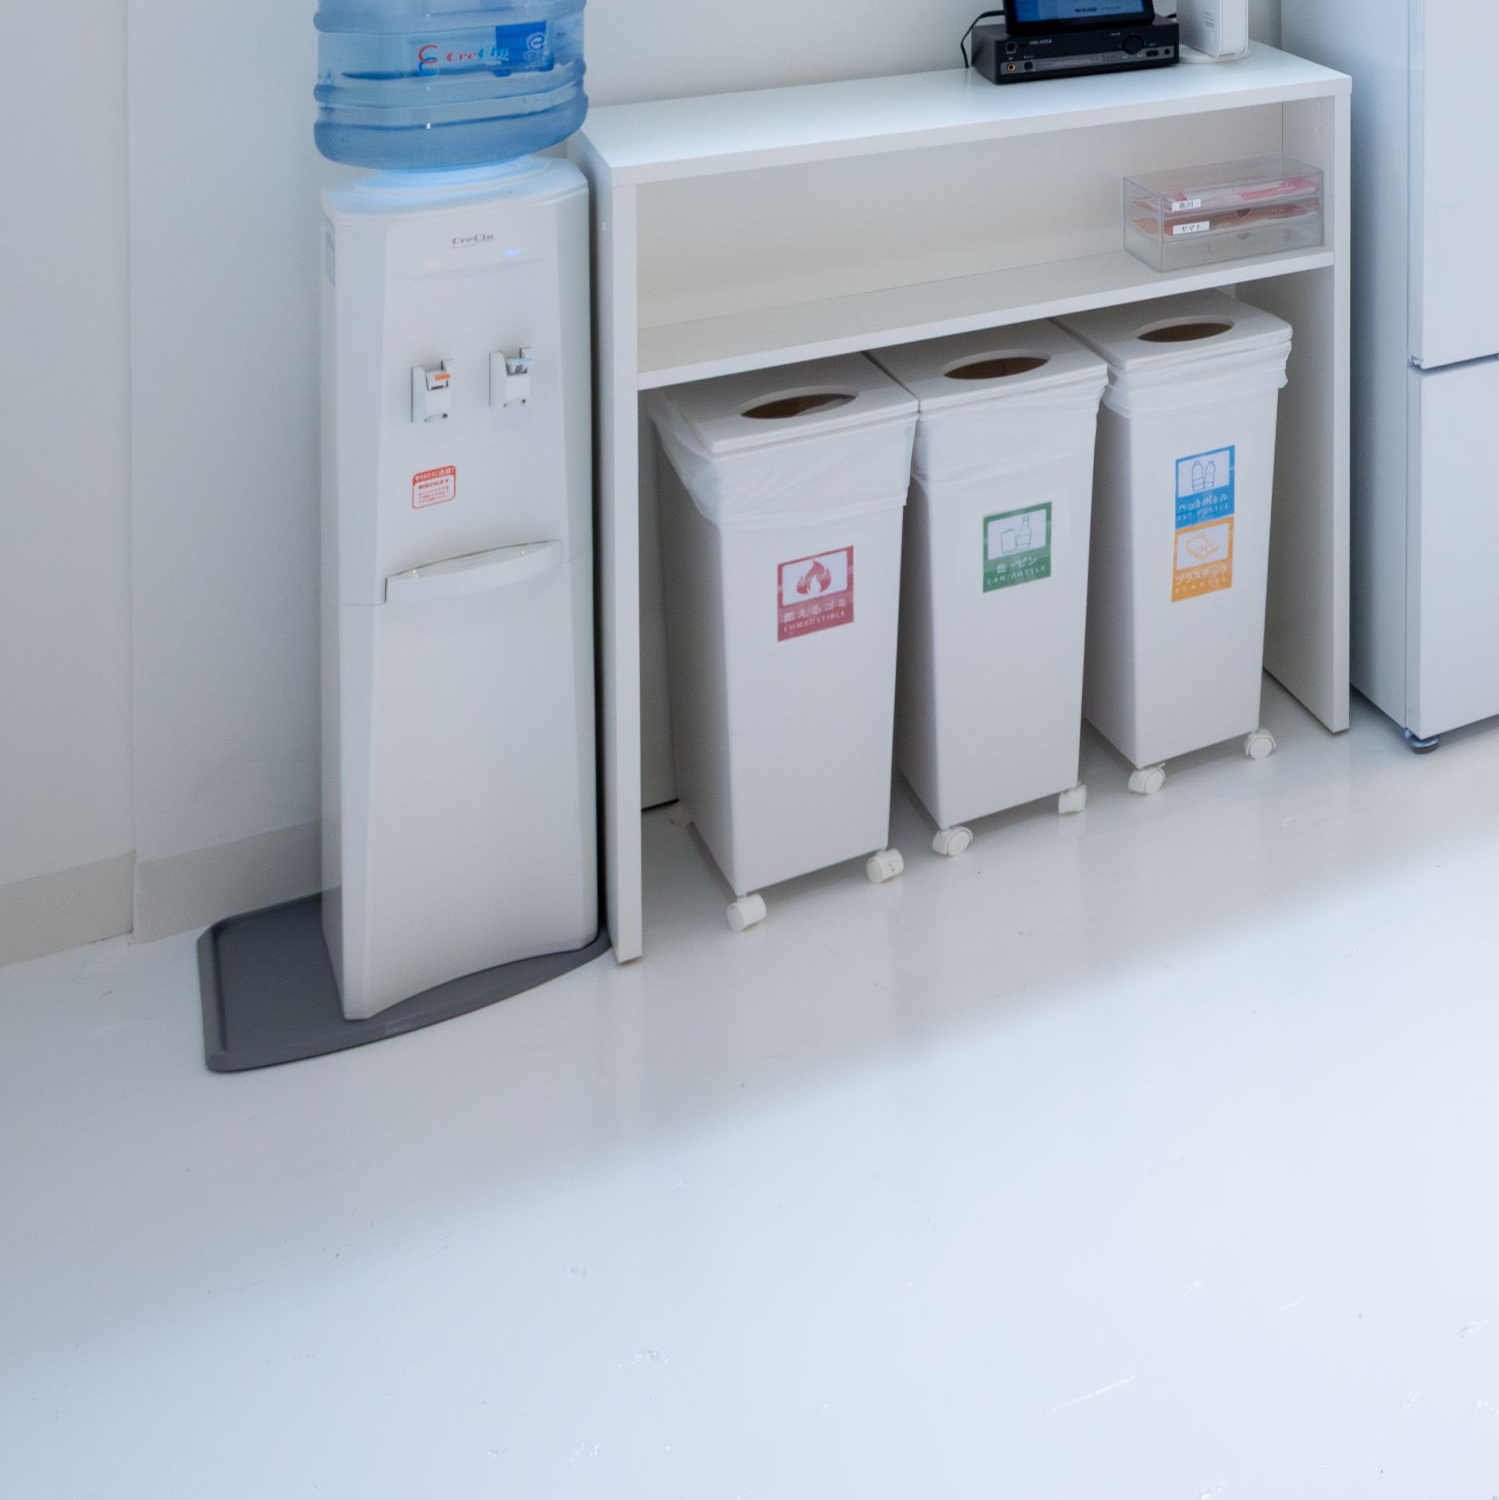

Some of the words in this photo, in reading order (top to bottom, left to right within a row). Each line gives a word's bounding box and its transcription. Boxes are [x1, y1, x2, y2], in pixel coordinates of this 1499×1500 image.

[1182, 223, 1200, 233] ヤマト
[1175, 563, 1228, 585] プラスチック
[783, 598, 846, 622] 燃えるゴミ
[783, 610, 845, 632] COMBUSTIBLE
